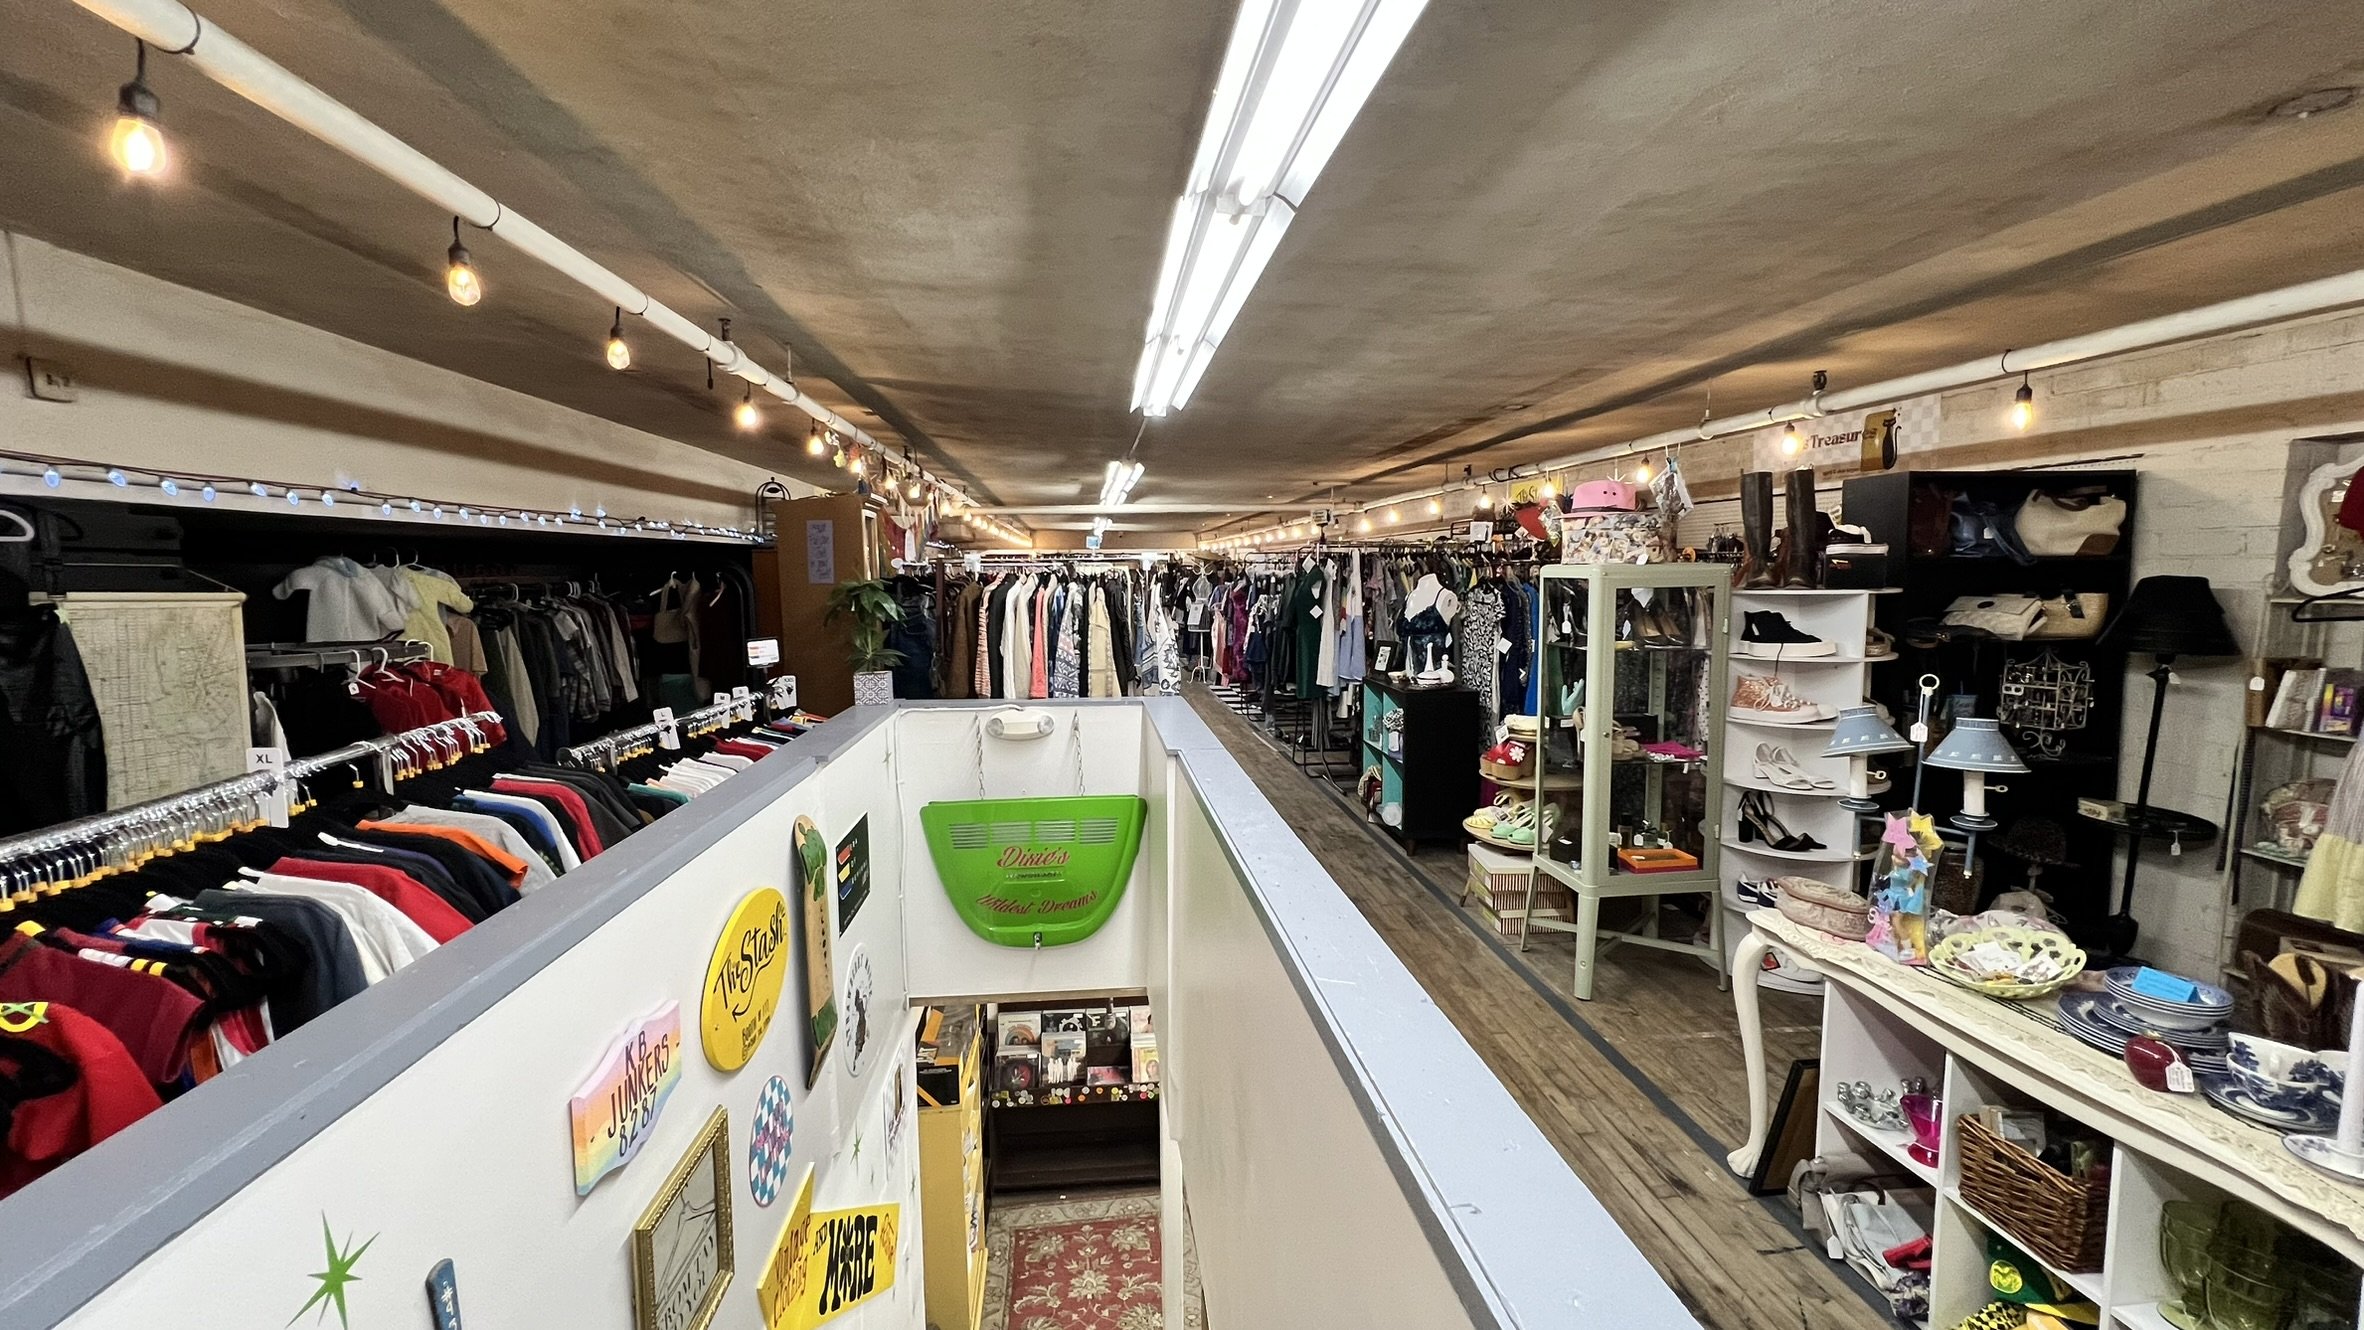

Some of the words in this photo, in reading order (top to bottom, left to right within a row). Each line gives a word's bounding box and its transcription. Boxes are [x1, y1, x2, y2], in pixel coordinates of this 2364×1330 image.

[256, 754, 273, 764] XL
[1038, 890, 1098, 914] Dreams
[713, 951, 741, 1009] The
[740, 901, 785, 993] Stash
[608, 1033, 670, 1138] JUNKERS
[619, 1086, 657, 1157] 8287
[818, 1213, 878, 1315] MORE
